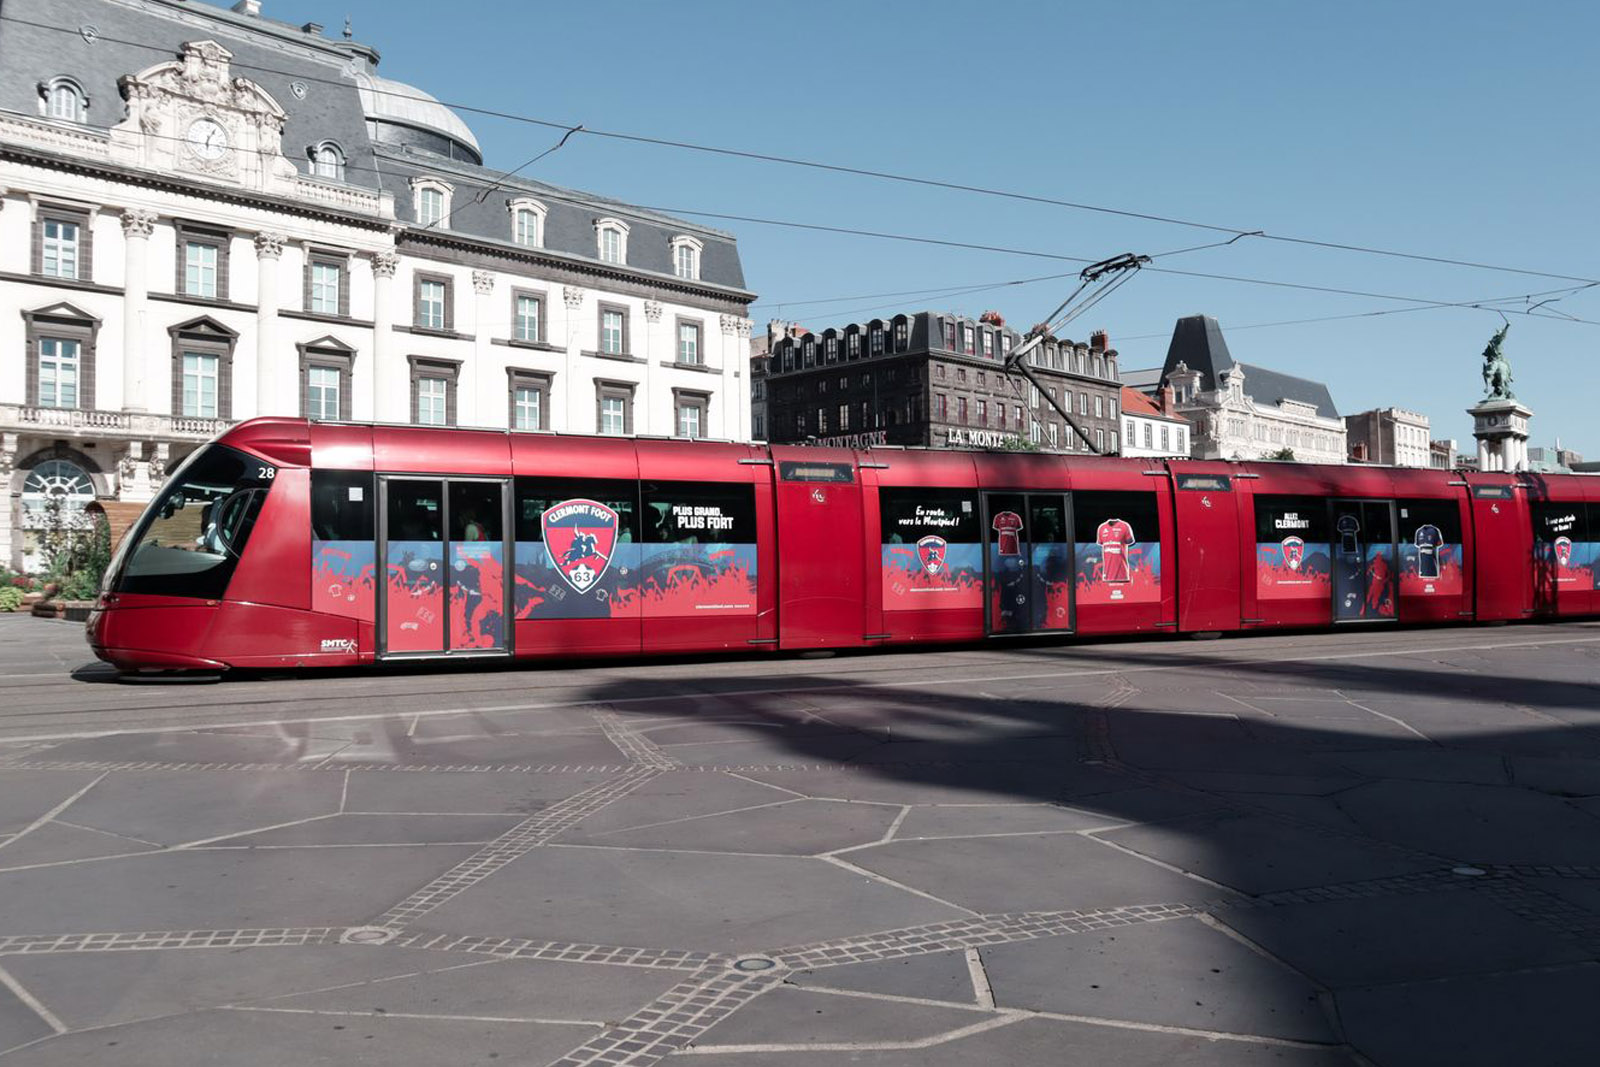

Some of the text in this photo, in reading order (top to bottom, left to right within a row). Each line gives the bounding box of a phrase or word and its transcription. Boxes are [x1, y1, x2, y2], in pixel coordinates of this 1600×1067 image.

[948, 428, 1018, 448] LA MONTAN
[258, 467, 275, 479] 28
[548, 505, 612, 523] CLERMONT FOOT
[672, 506, 723, 517] PLUS GRAND,
[915, 505, 945, 516] En route
[677, 516, 734, 529] PLUS FORT
[1275, 520, 1309, 528] CLERMONT
[574, 572, 591, 582] 63
[321, 639, 349, 647] SMTC
